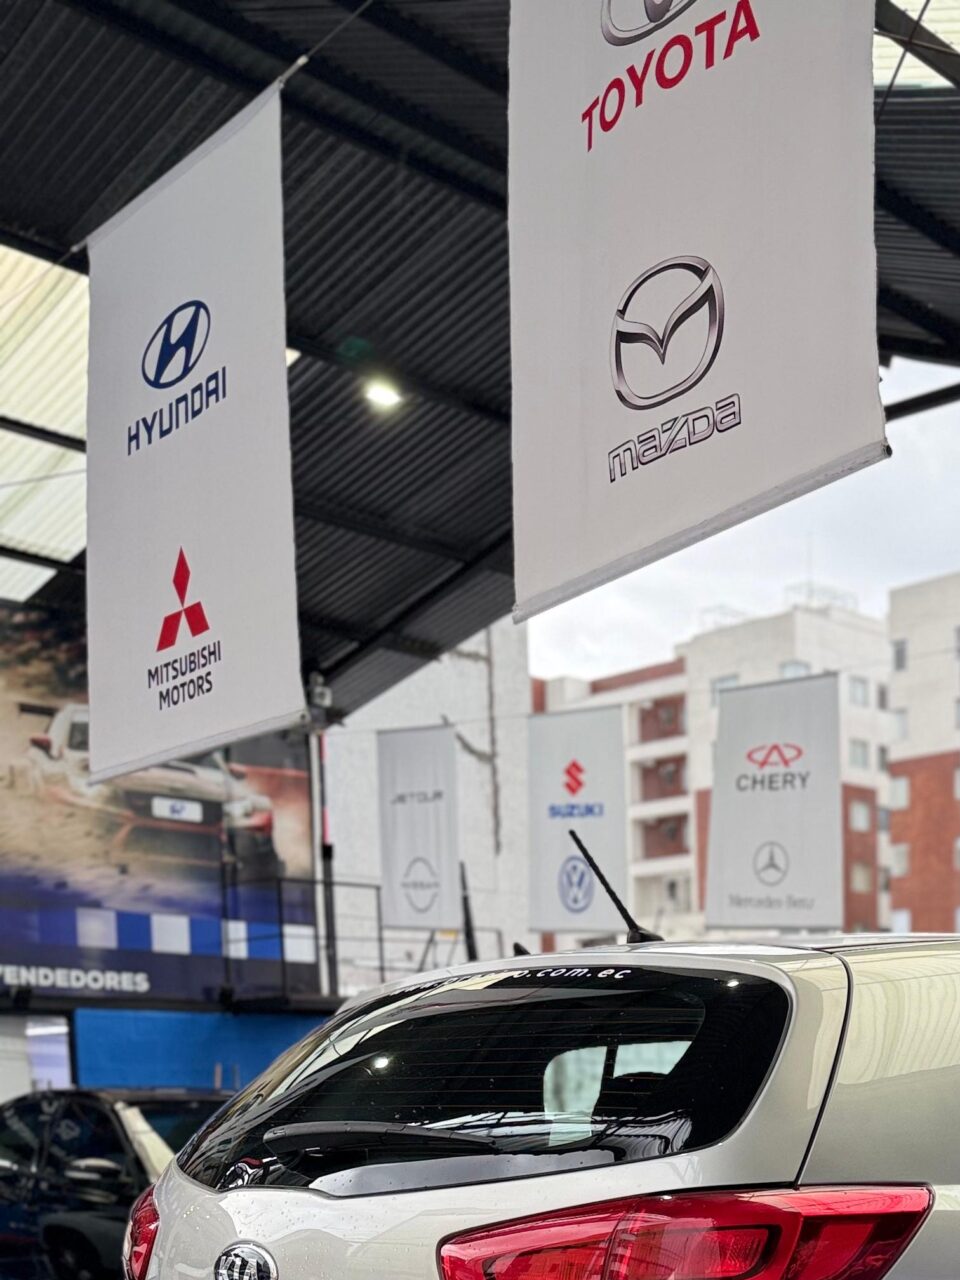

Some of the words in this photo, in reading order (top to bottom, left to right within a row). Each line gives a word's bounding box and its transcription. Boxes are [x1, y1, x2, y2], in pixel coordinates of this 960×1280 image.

[581, 0, 761, 153] TOYOTA
[127, 366, 227, 456] HYUNDAI
[147, 640, 222, 689] MITSUBISHI
[159, 673, 214, 711] MOTORS
[736, 771, 811, 792] CHERY
[548, 803, 604, 818] SUZUKI
[0, 963, 150, 993] ENDEDORES
